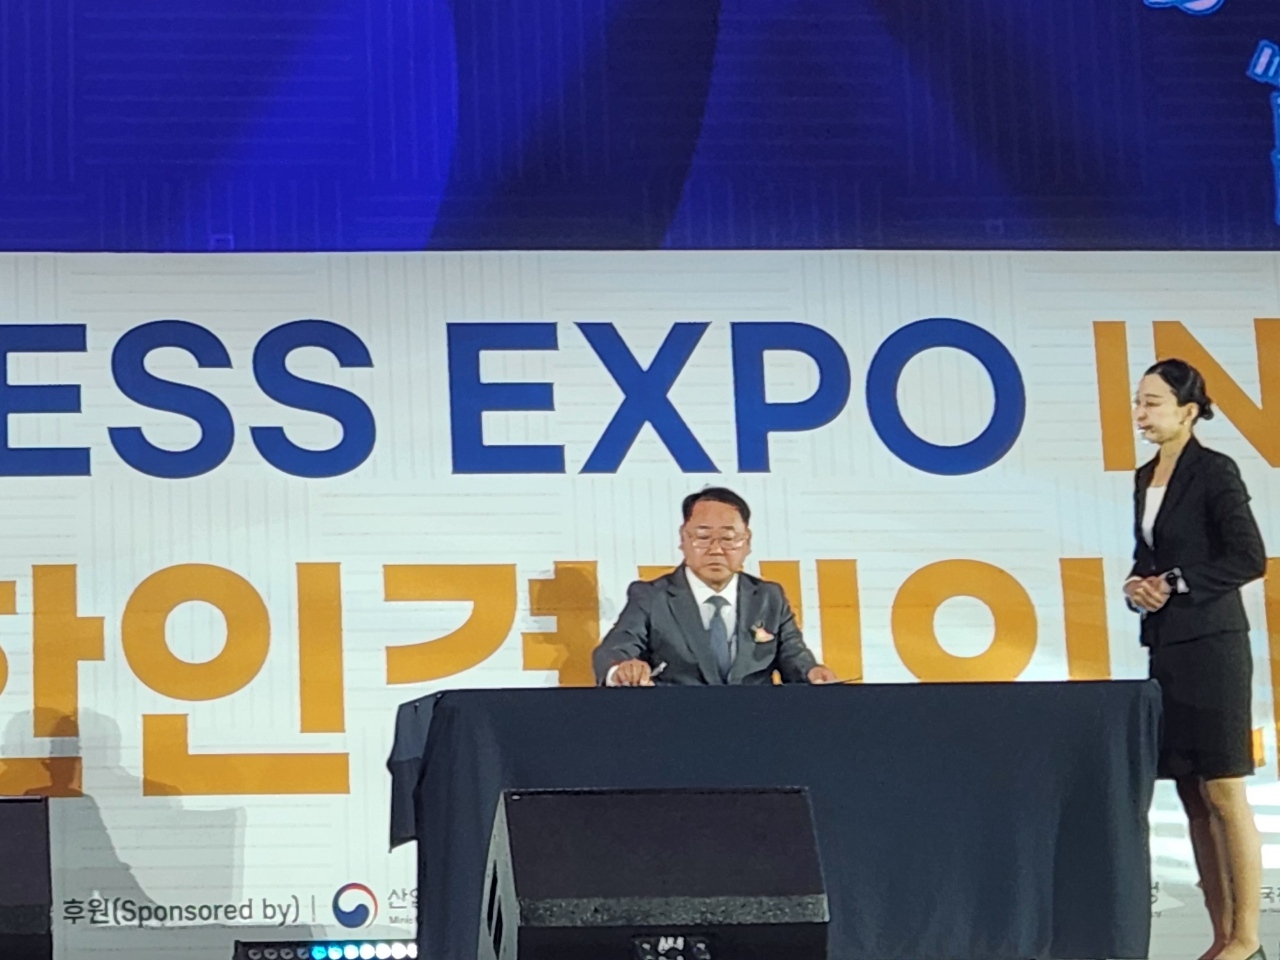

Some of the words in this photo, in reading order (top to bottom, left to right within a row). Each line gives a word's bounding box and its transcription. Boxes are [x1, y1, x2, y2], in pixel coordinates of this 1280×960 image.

[447, 318, 1026, 475] EXPO
[63, 897, 254, 928] 후원(Sponsored
[262, 895, 300, 927] by)
